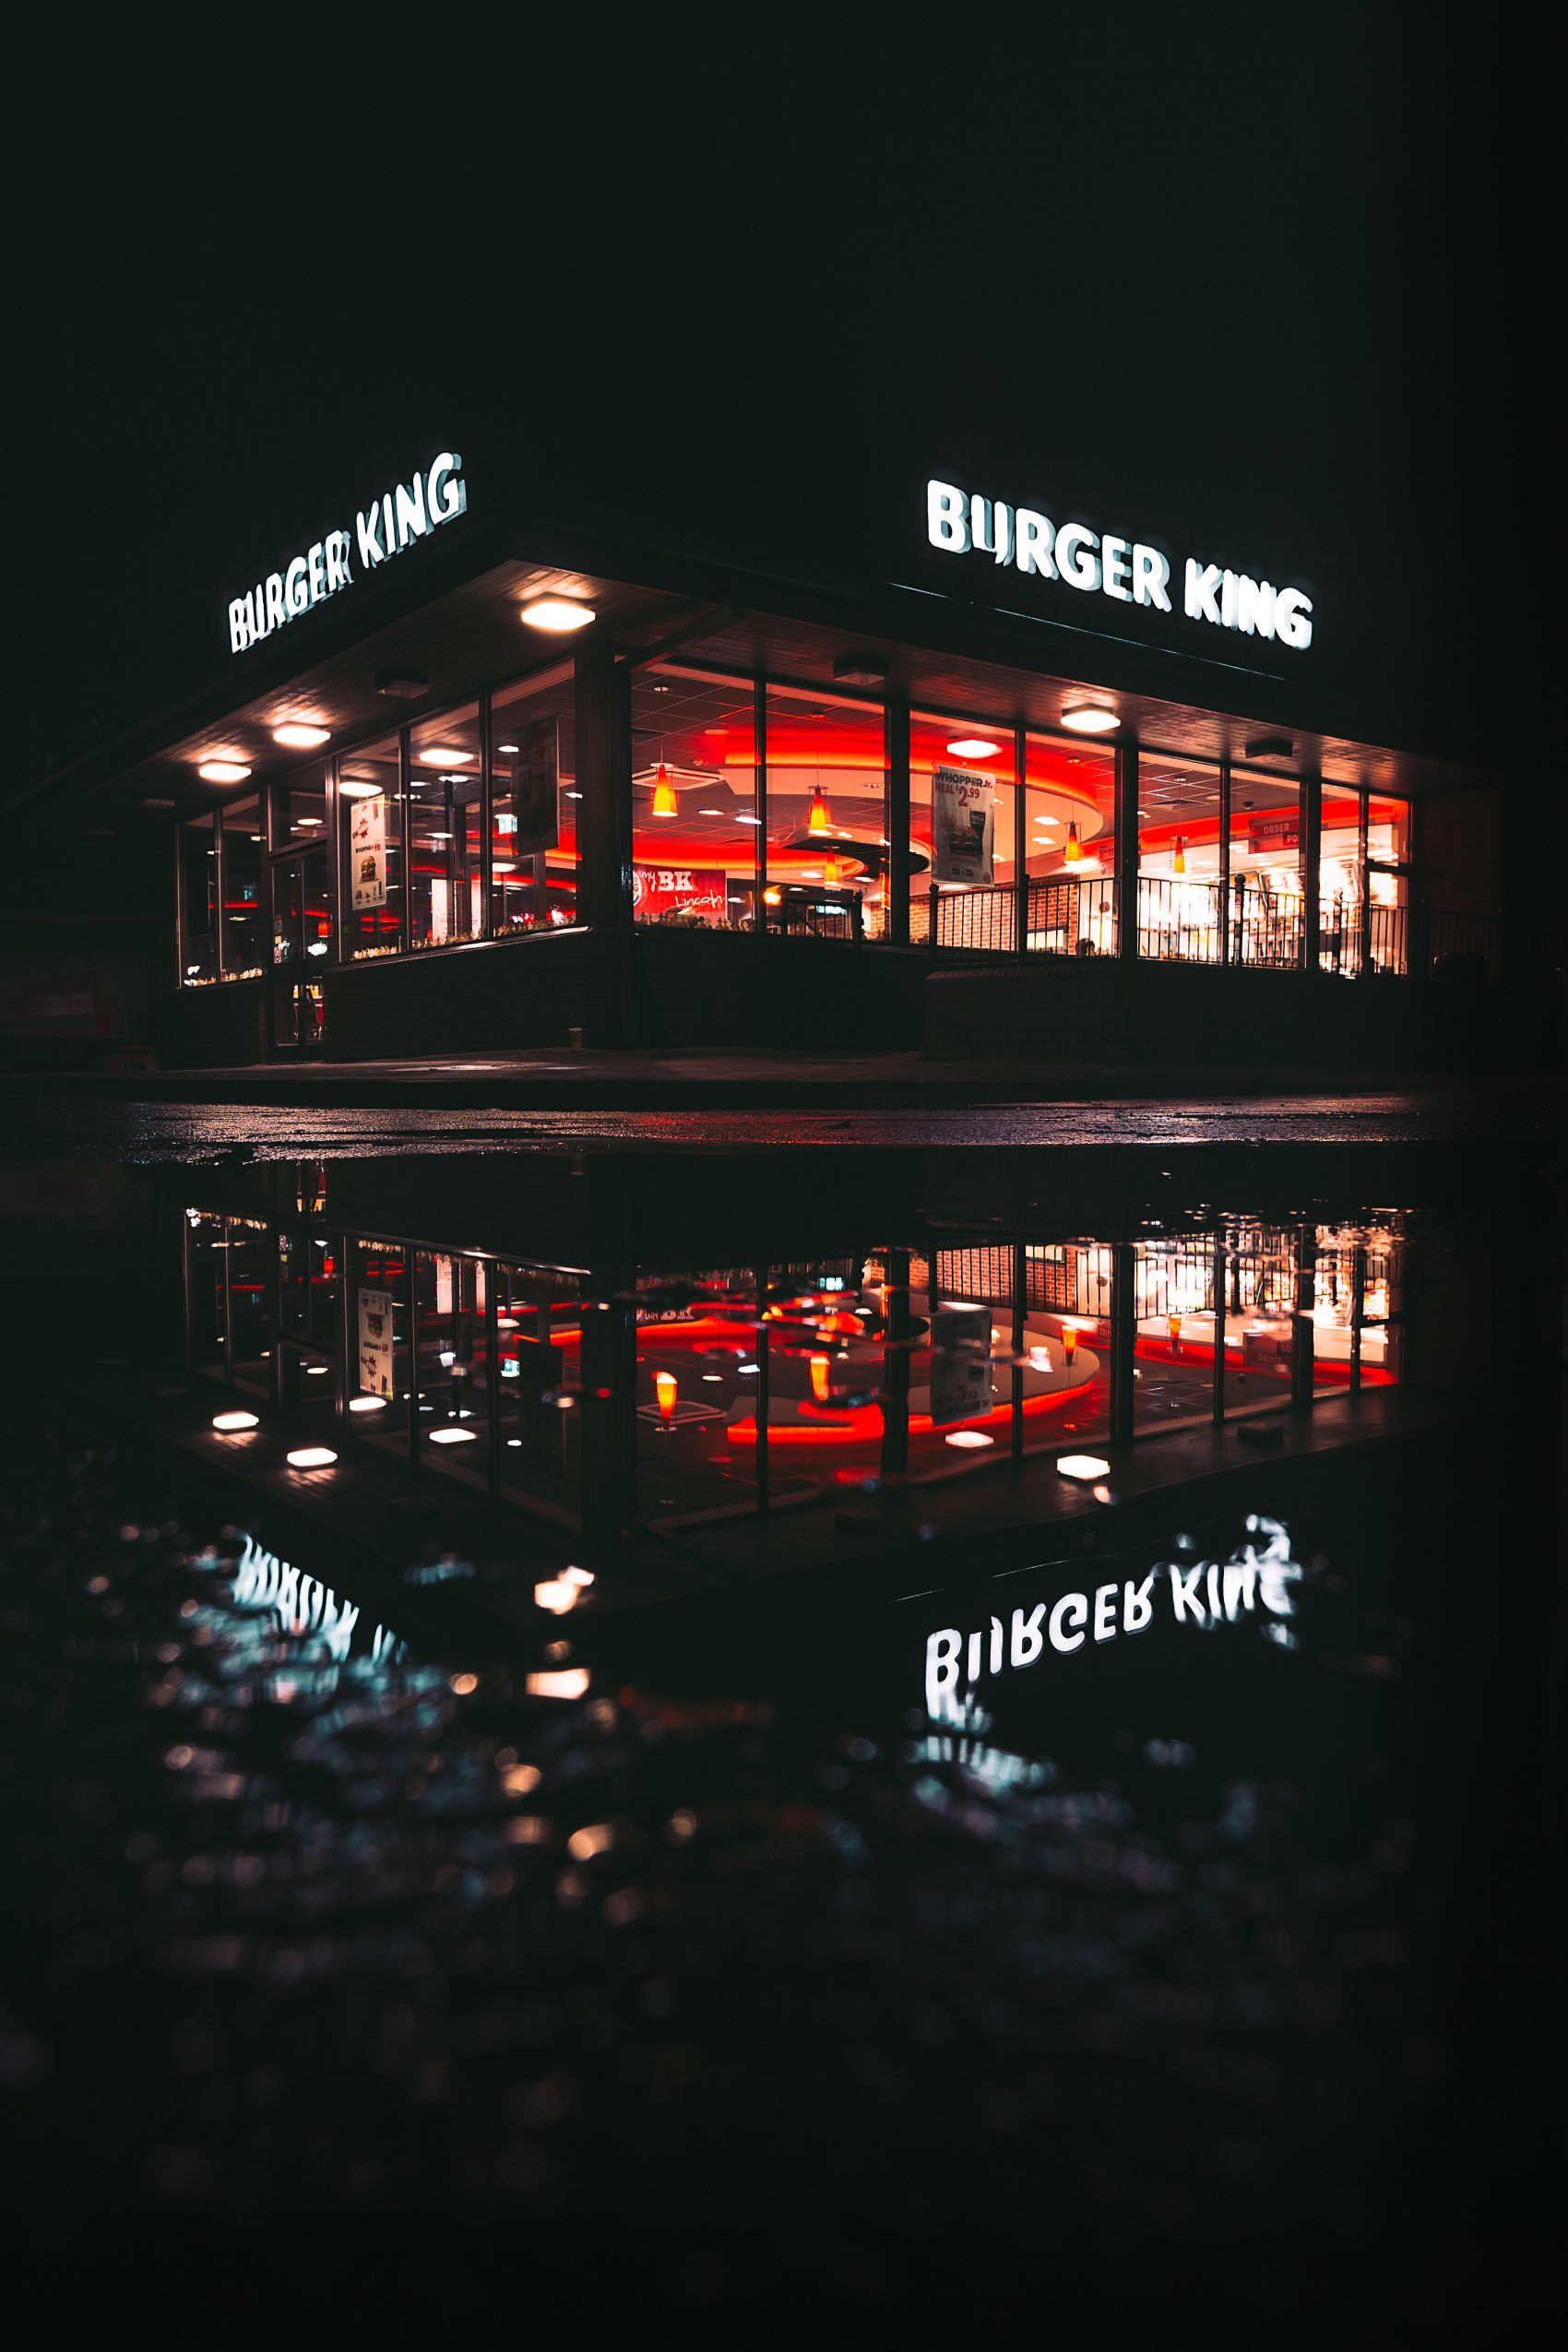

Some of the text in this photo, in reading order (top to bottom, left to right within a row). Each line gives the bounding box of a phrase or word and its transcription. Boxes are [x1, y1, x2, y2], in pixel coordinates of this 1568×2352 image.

[229, 452, 467, 653] BURGER KING
[927, 479, 1313, 650] BURGER KING
[934, 772, 983, 788] WHOPPER
[1263, 822, 1290, 835] ORDER
[658, 871, 694, 892] BK
